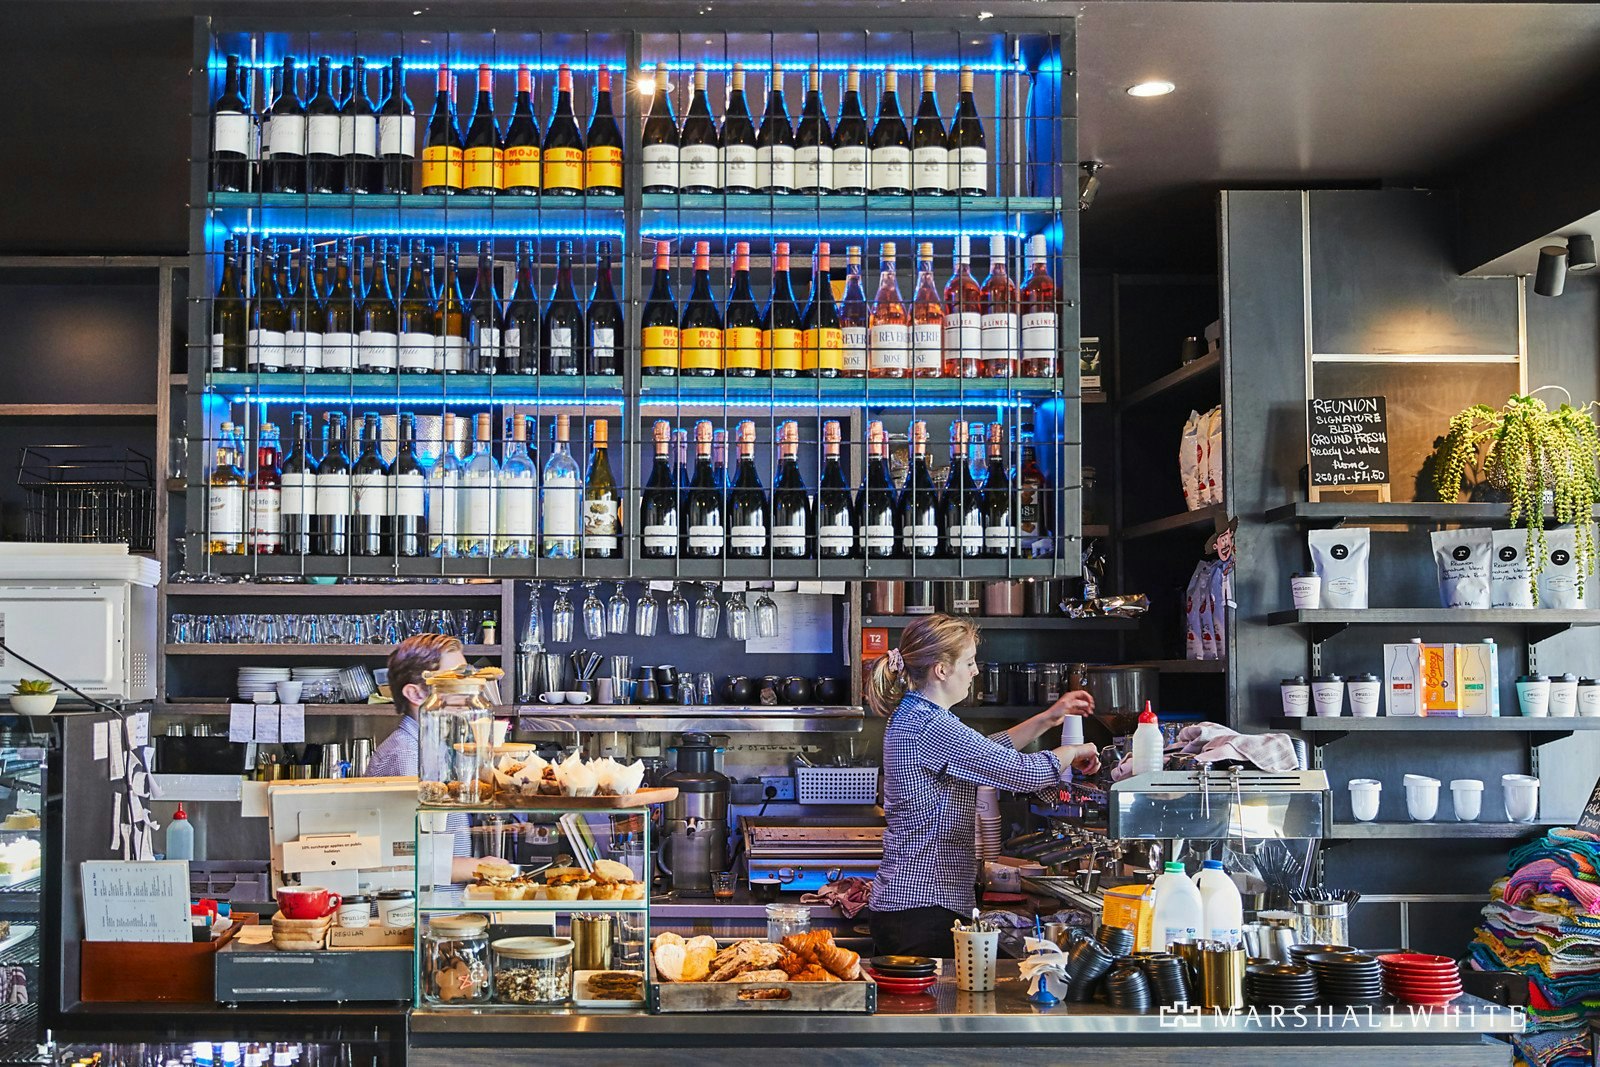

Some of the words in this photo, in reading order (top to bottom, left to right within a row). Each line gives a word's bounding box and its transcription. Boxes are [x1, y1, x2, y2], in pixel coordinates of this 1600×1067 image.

[508, 149, 539, 158] MOJO
[1313, 398, 1377, 414] REUNION
[1316, 413, 1382, 425] SIGNATURE
[1328, 423, 1363, 434] BLEND
[1311, 433, 1352, 446] GROUND
[1354, 432, 1387, 445] FRESH
[1310, 446, 1343, 461] Ready
[869, 634, 881, 643] T2
[334, 930, 364, 938] REGULAR
